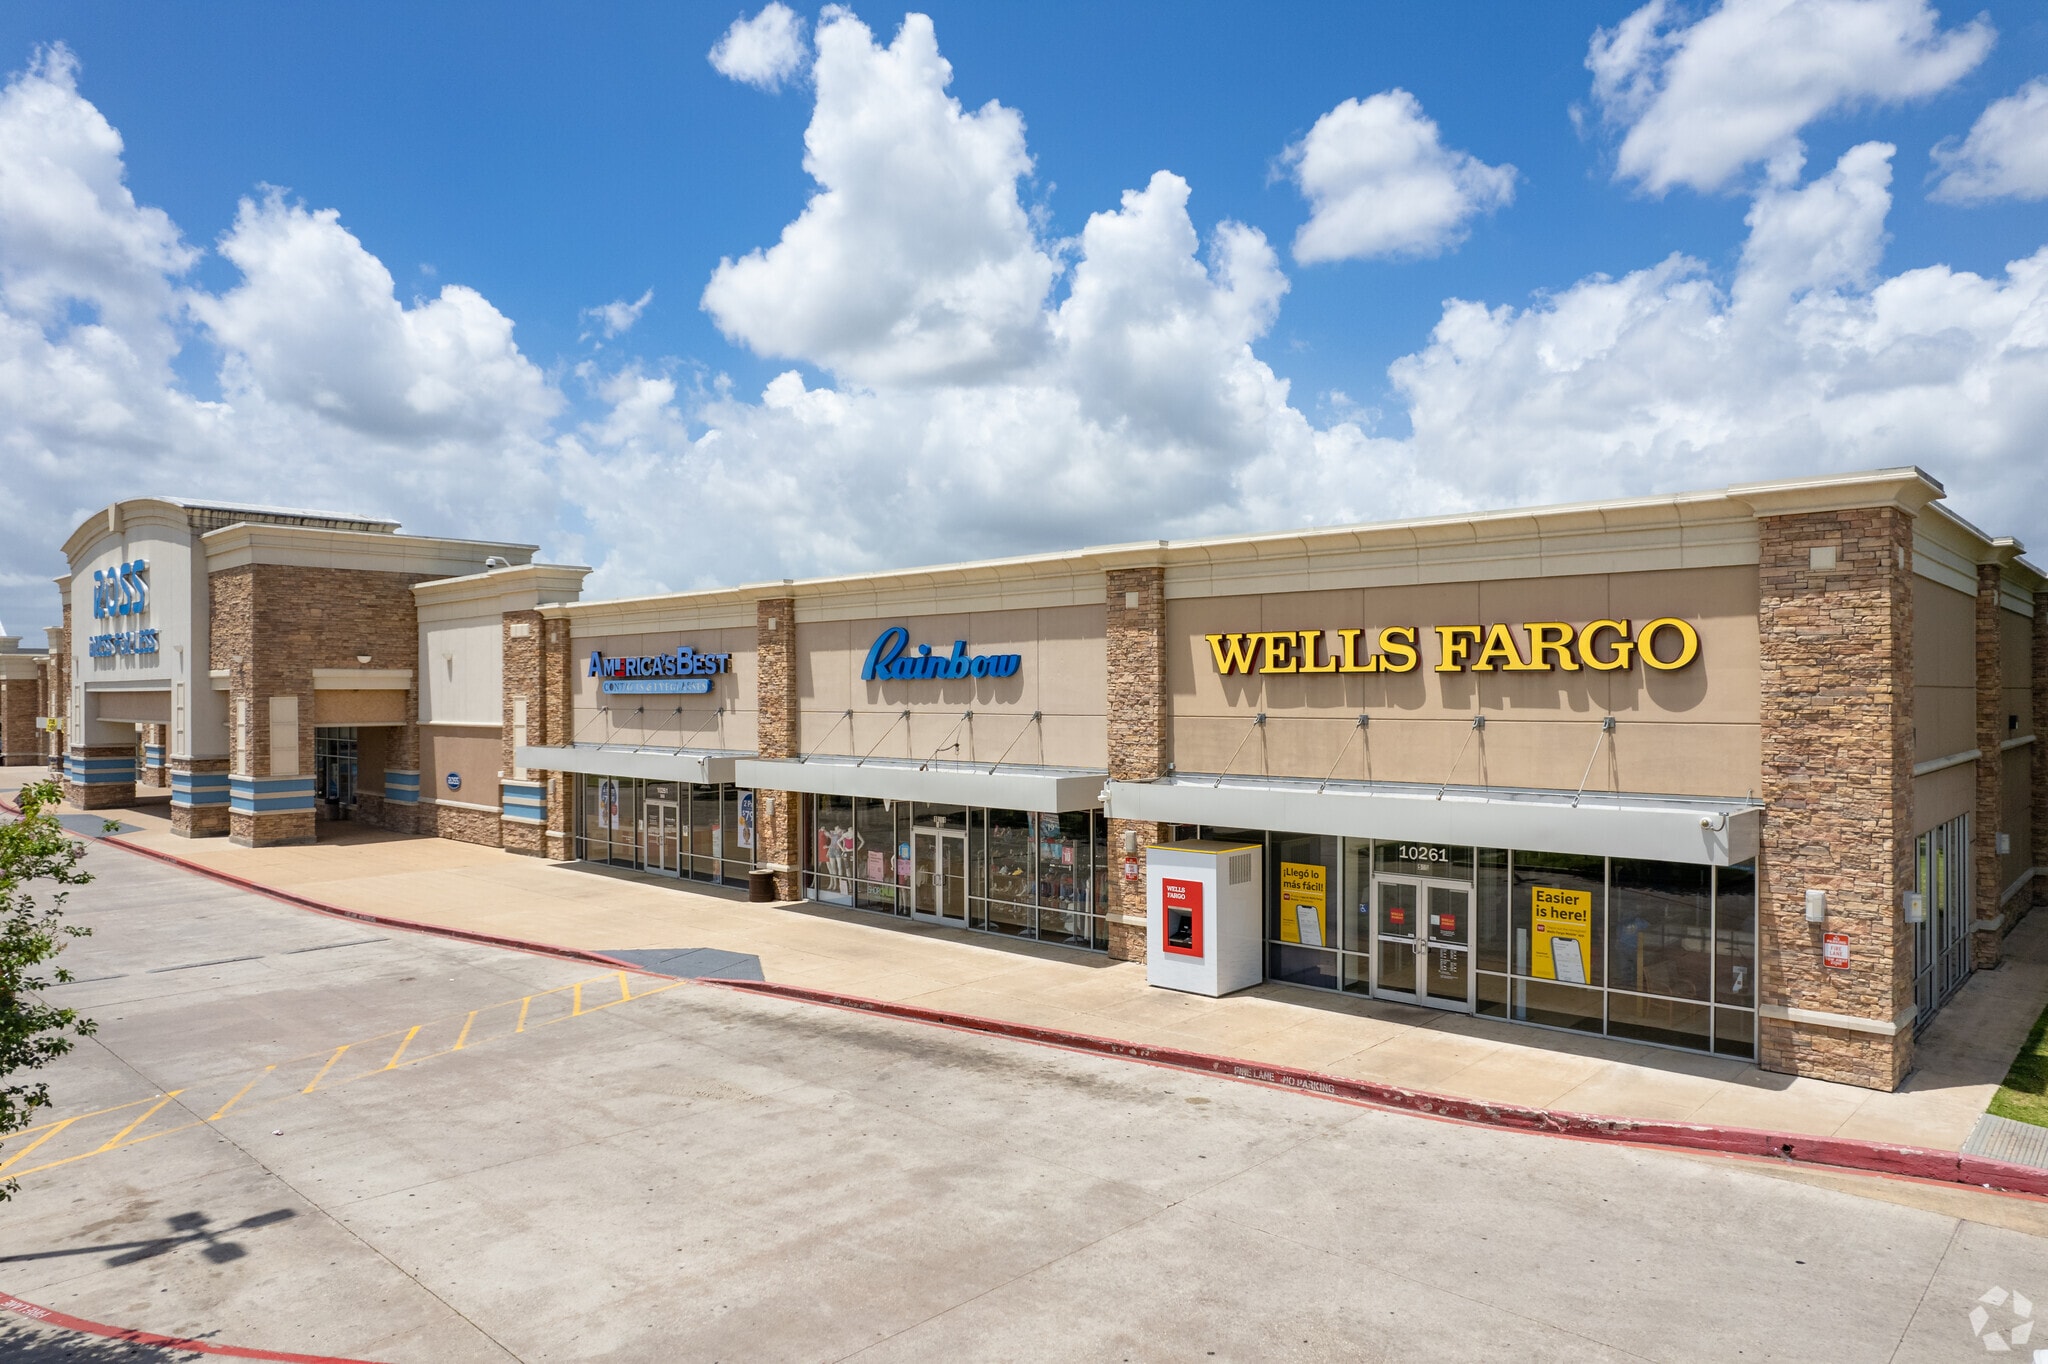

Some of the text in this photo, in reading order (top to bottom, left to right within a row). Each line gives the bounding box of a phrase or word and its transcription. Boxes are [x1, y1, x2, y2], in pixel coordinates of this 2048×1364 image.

[93, 559, 147, 619] ROSS
[860, 626, 1022, 681] Rainbow
[1205, 616, 1699, 675] WELLS FARGO
[1399, 844, 1449, 862] 10261
[1283, 867, 1320, 879] ¡Llegó lo
[1167, 885, 1186, 893] WELLS
[1283, 880, 1324, 892] más fácil!
[1167, 892, 1186, 900] FARGO
[1536, 890, 1580, 906] Easier
[1536, 904, 1587, 922] is here!
[1234, 1066, 1252, 1078] FIRE
[1253, 1070, 1275, 1082] LANE
[1296, 1079, 1336, 1094] PARKING
